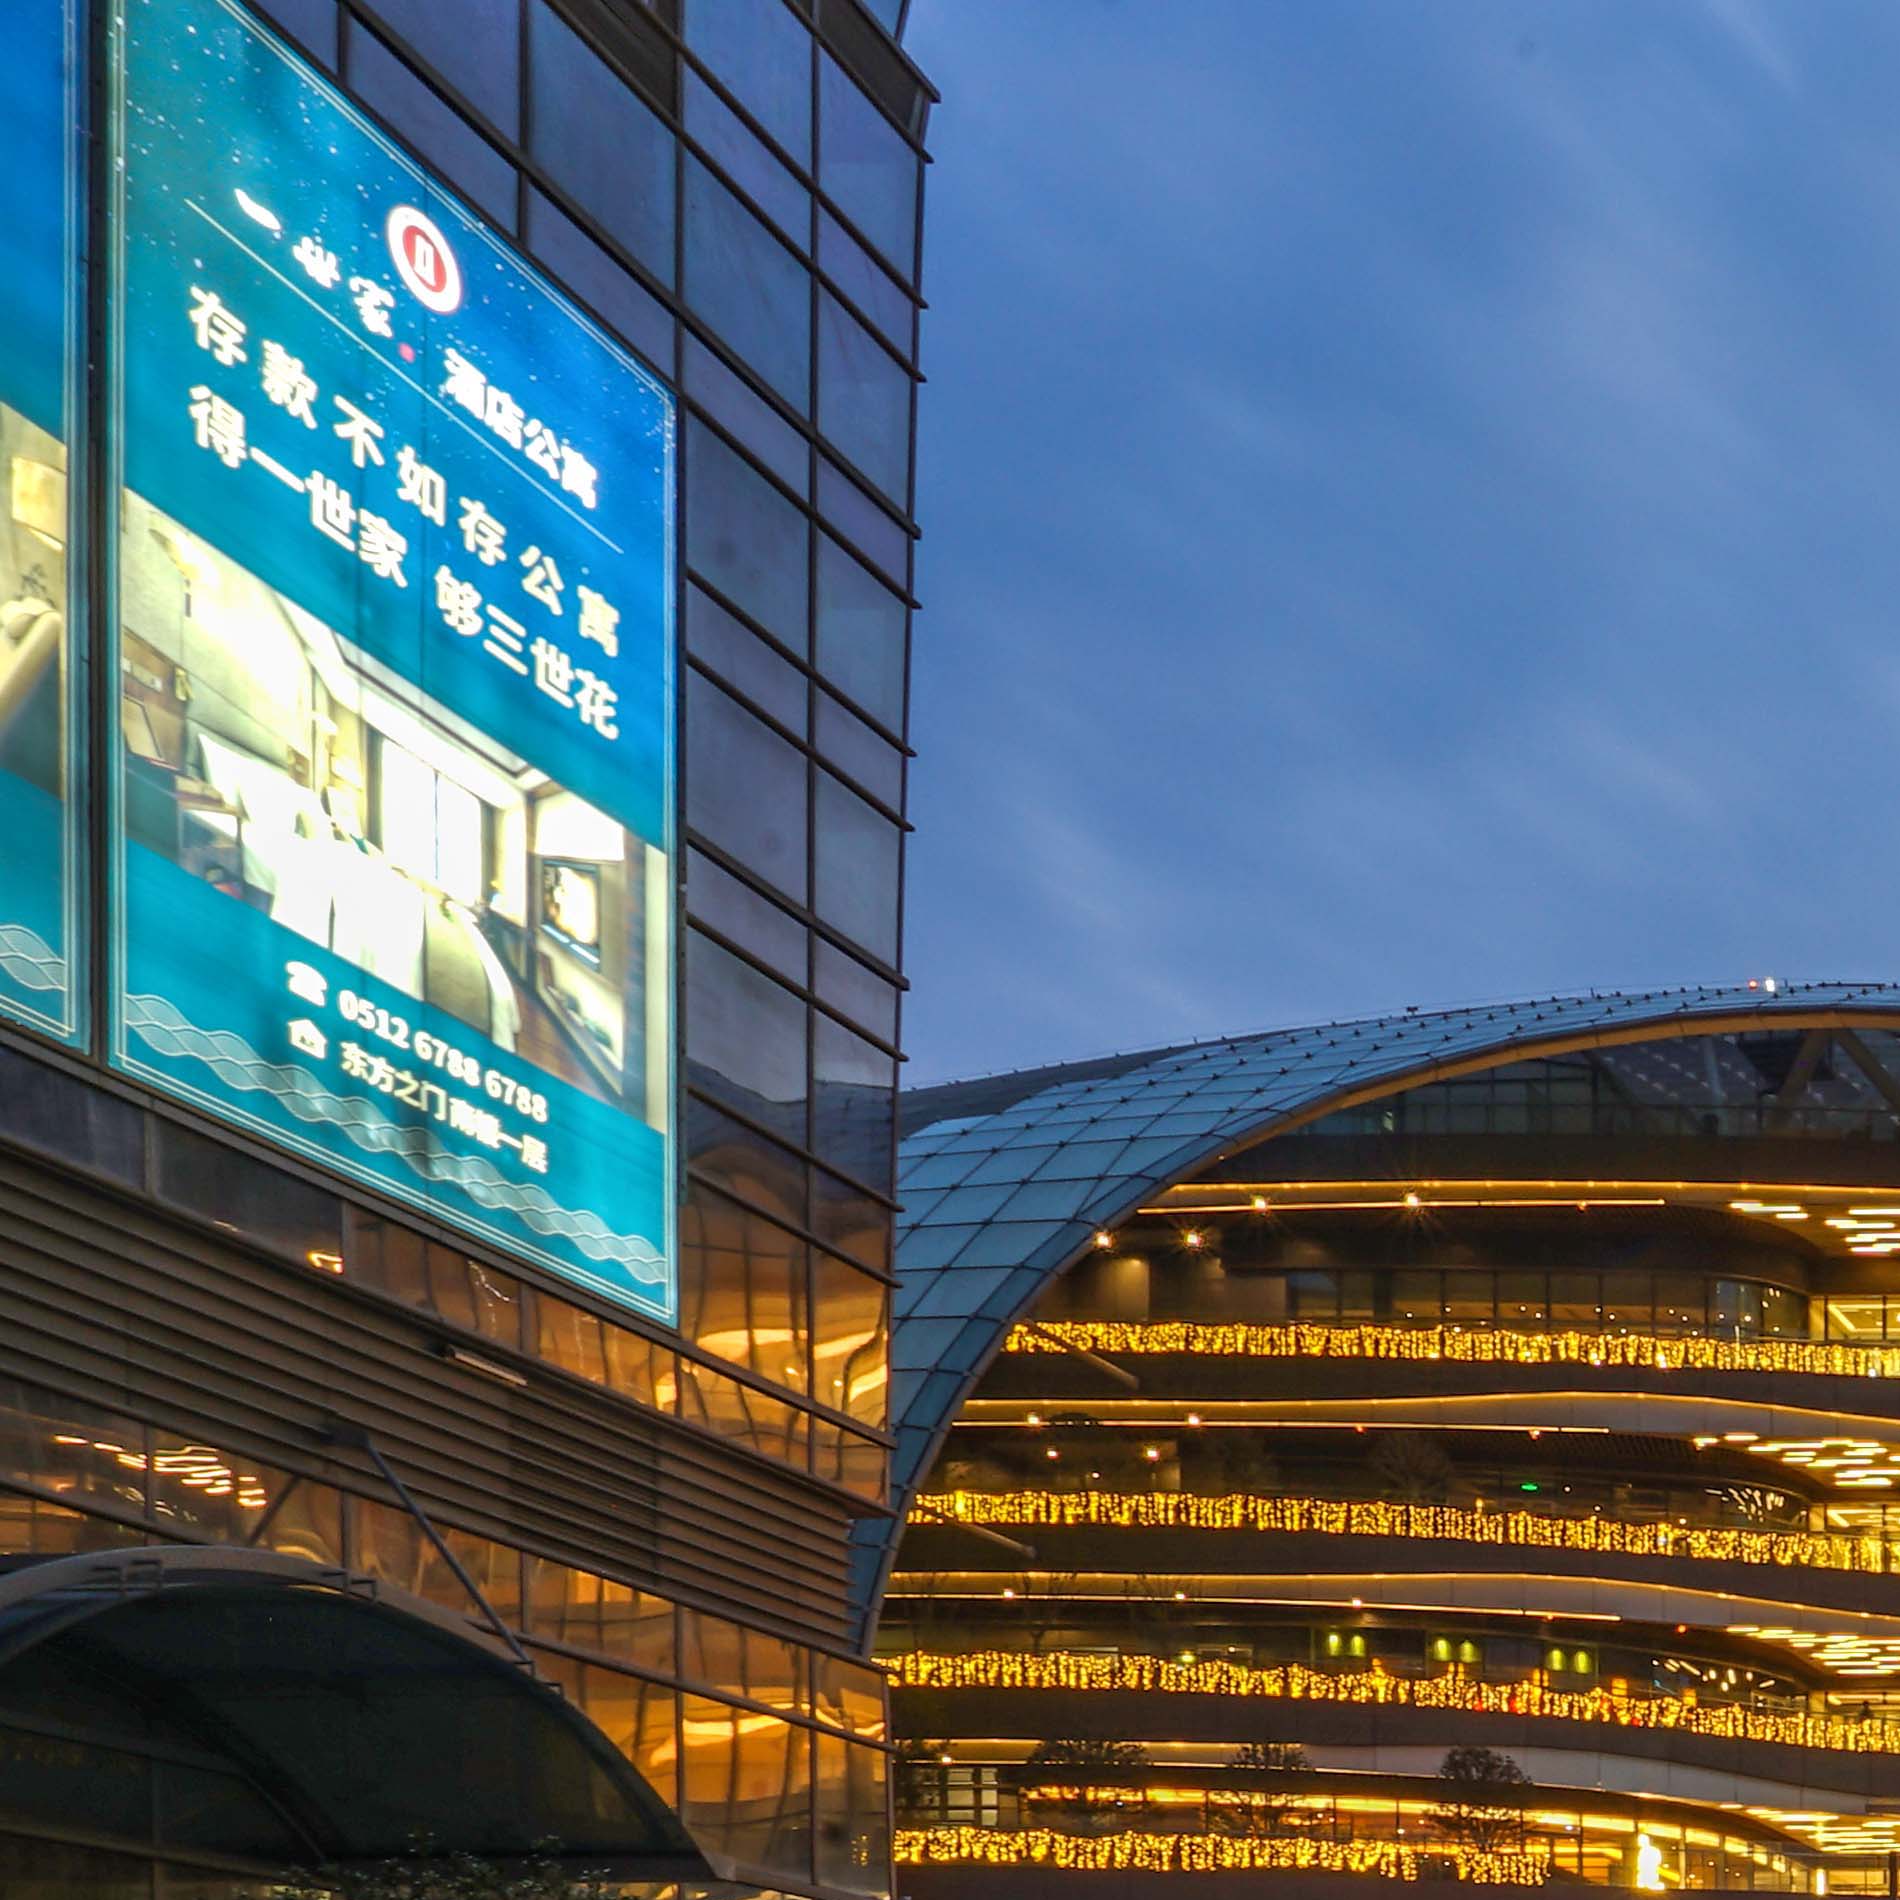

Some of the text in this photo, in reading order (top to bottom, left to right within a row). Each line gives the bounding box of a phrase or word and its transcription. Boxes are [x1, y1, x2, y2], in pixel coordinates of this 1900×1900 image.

[188, 286, 620, 657] 存款不如存公寓
[441, 348, 599, 509] 酒店公寓
[188, 384, 620, 740] 得一世家 够三世花
[338, 990, 548, 1123] 0512 6788 6788
